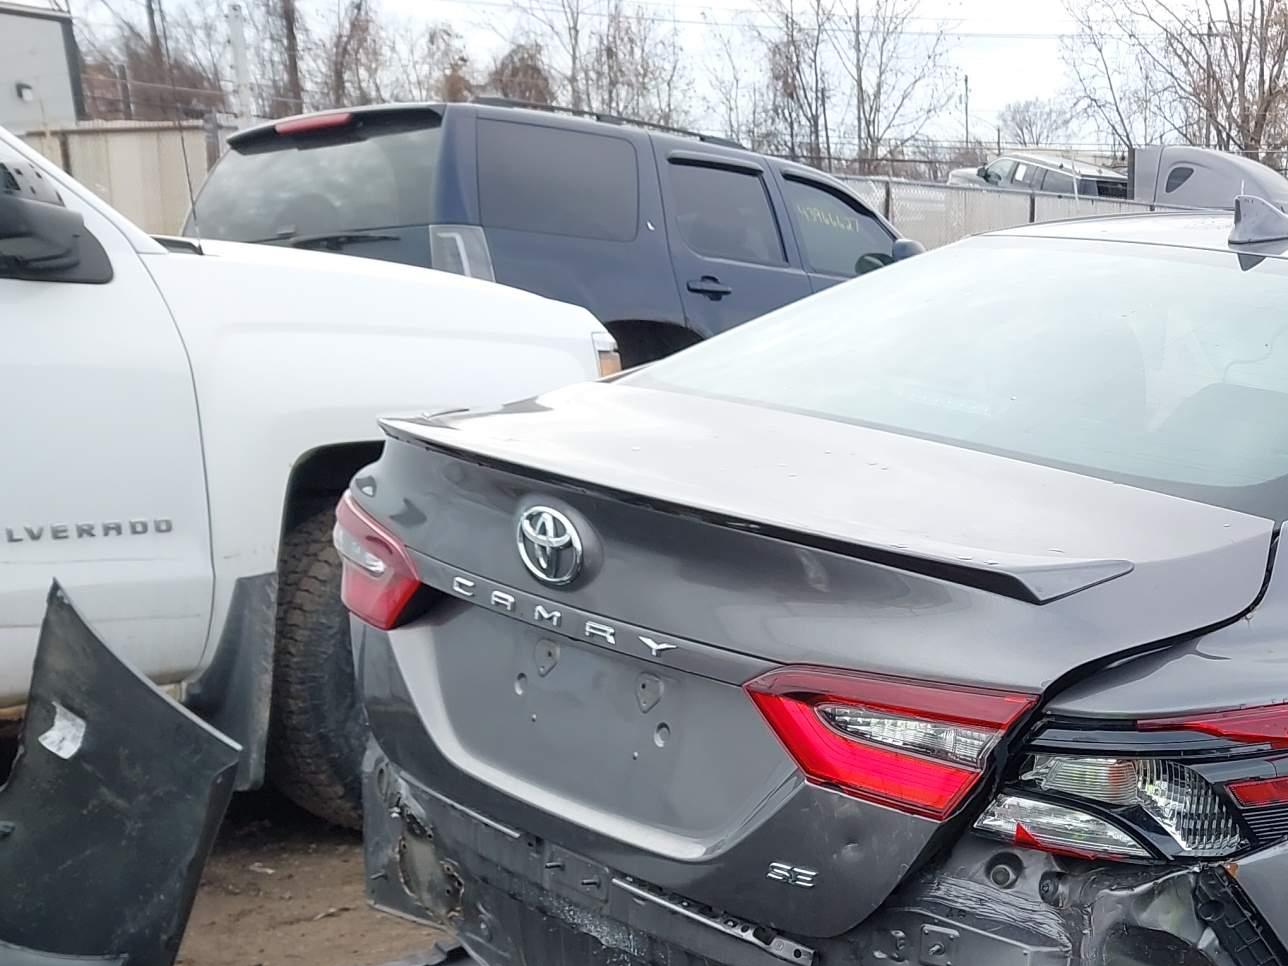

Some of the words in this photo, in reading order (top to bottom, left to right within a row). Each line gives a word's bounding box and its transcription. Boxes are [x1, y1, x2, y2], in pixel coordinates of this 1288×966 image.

[6, 519, 173, 543] LVERADO
[453, 576, 677, 657] CAMRY
[767, 862, 818, 887] SE
